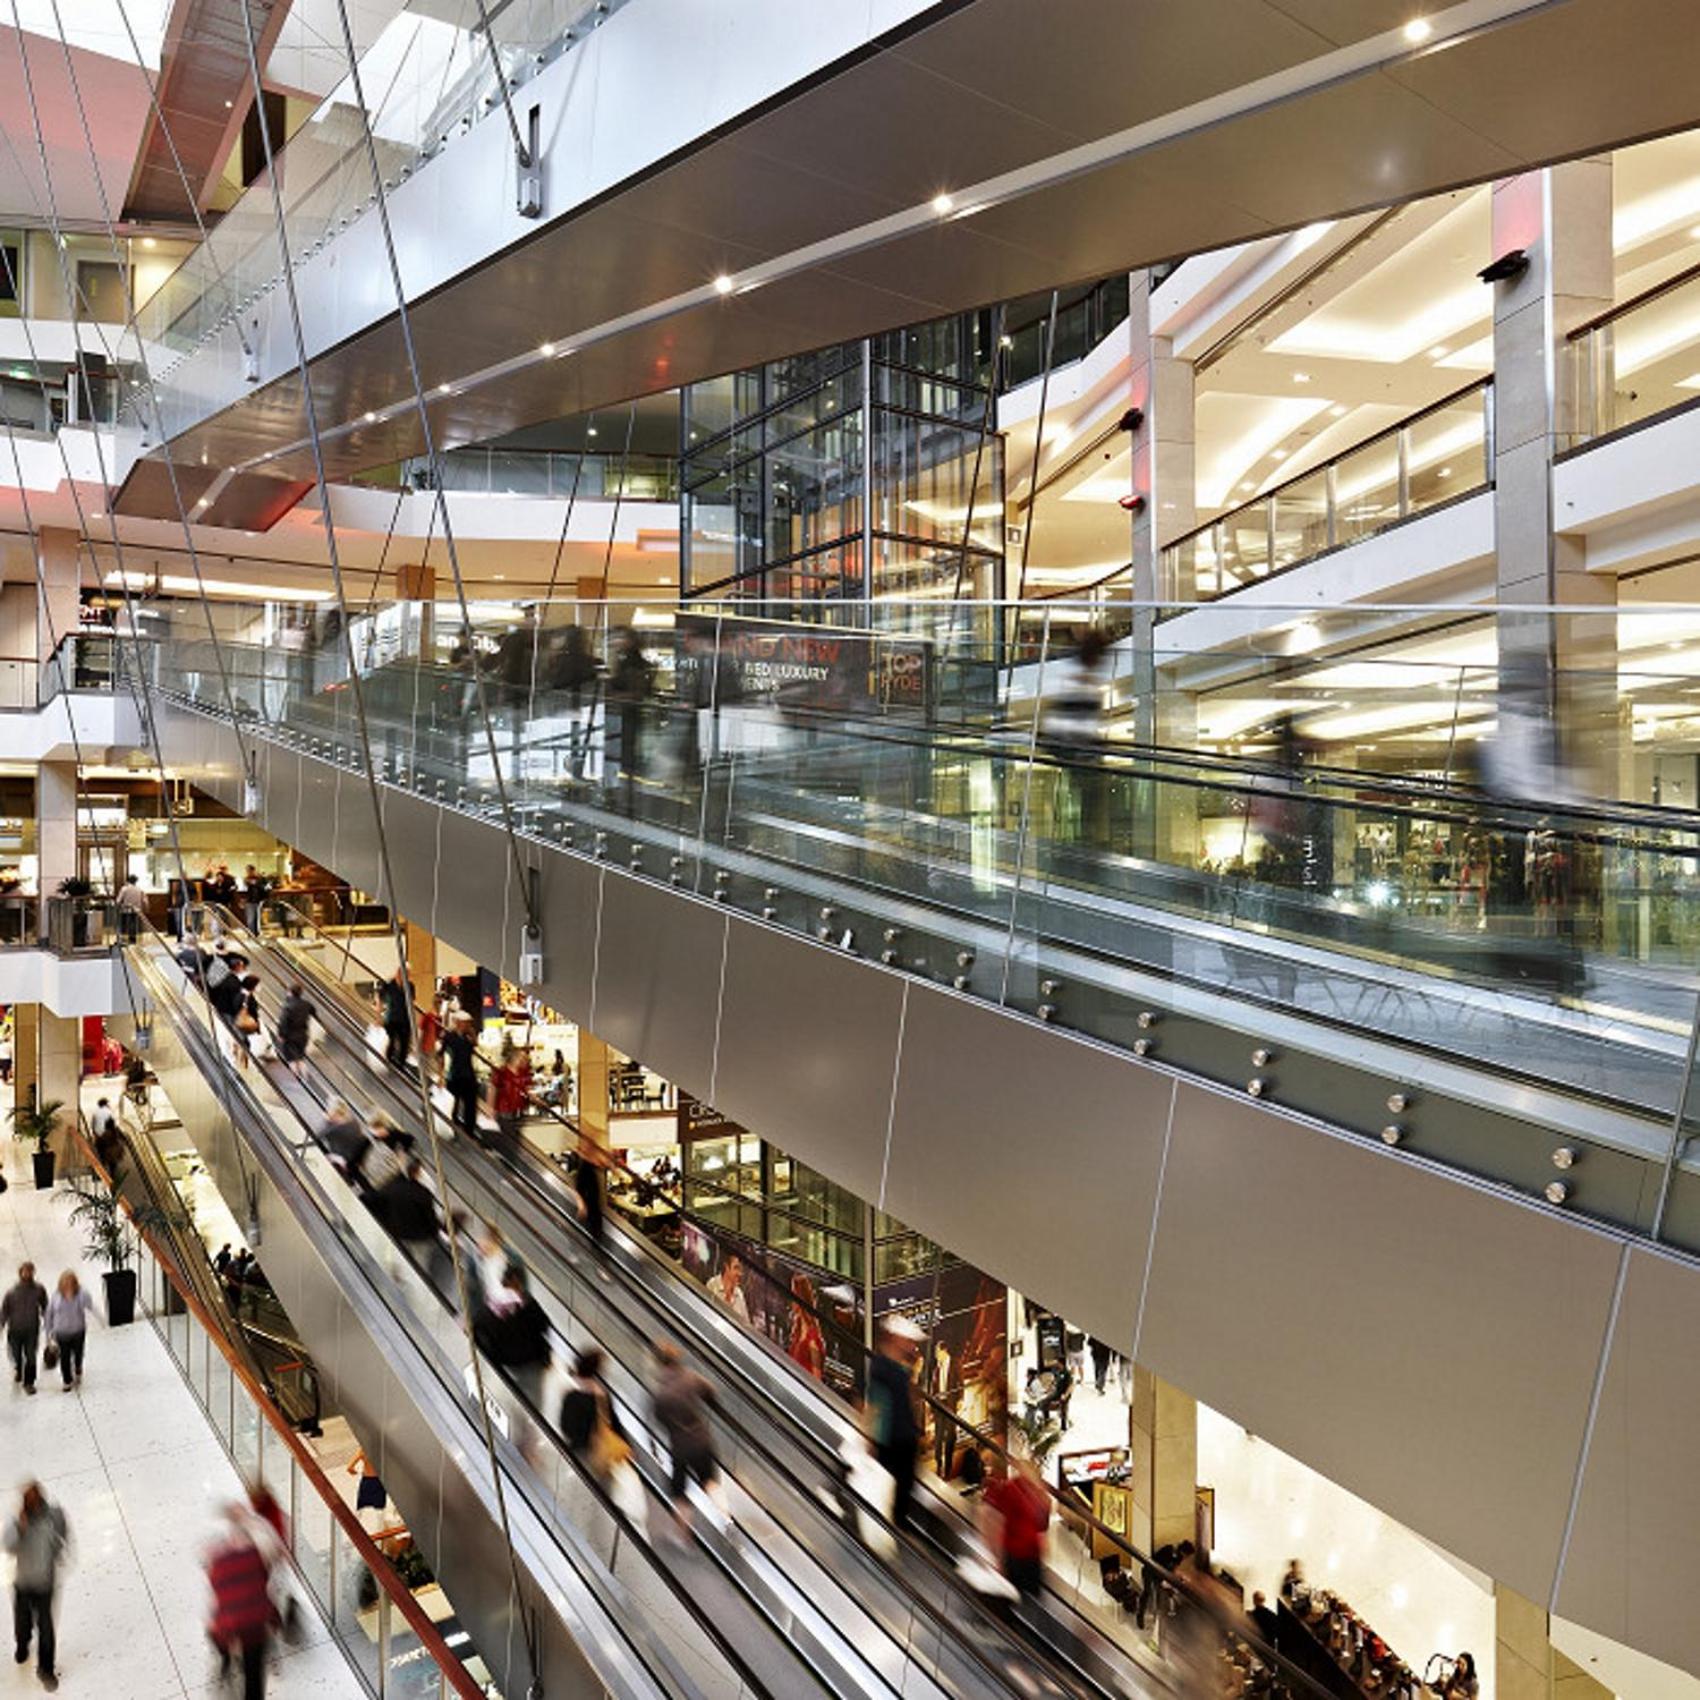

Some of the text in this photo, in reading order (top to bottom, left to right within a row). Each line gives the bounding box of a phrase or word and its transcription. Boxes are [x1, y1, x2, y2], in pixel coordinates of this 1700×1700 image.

[783, 635, 842, 664] NEW
[776, 663, 829, 682] LUXURY
[881, 652, 921, 675] TOP
